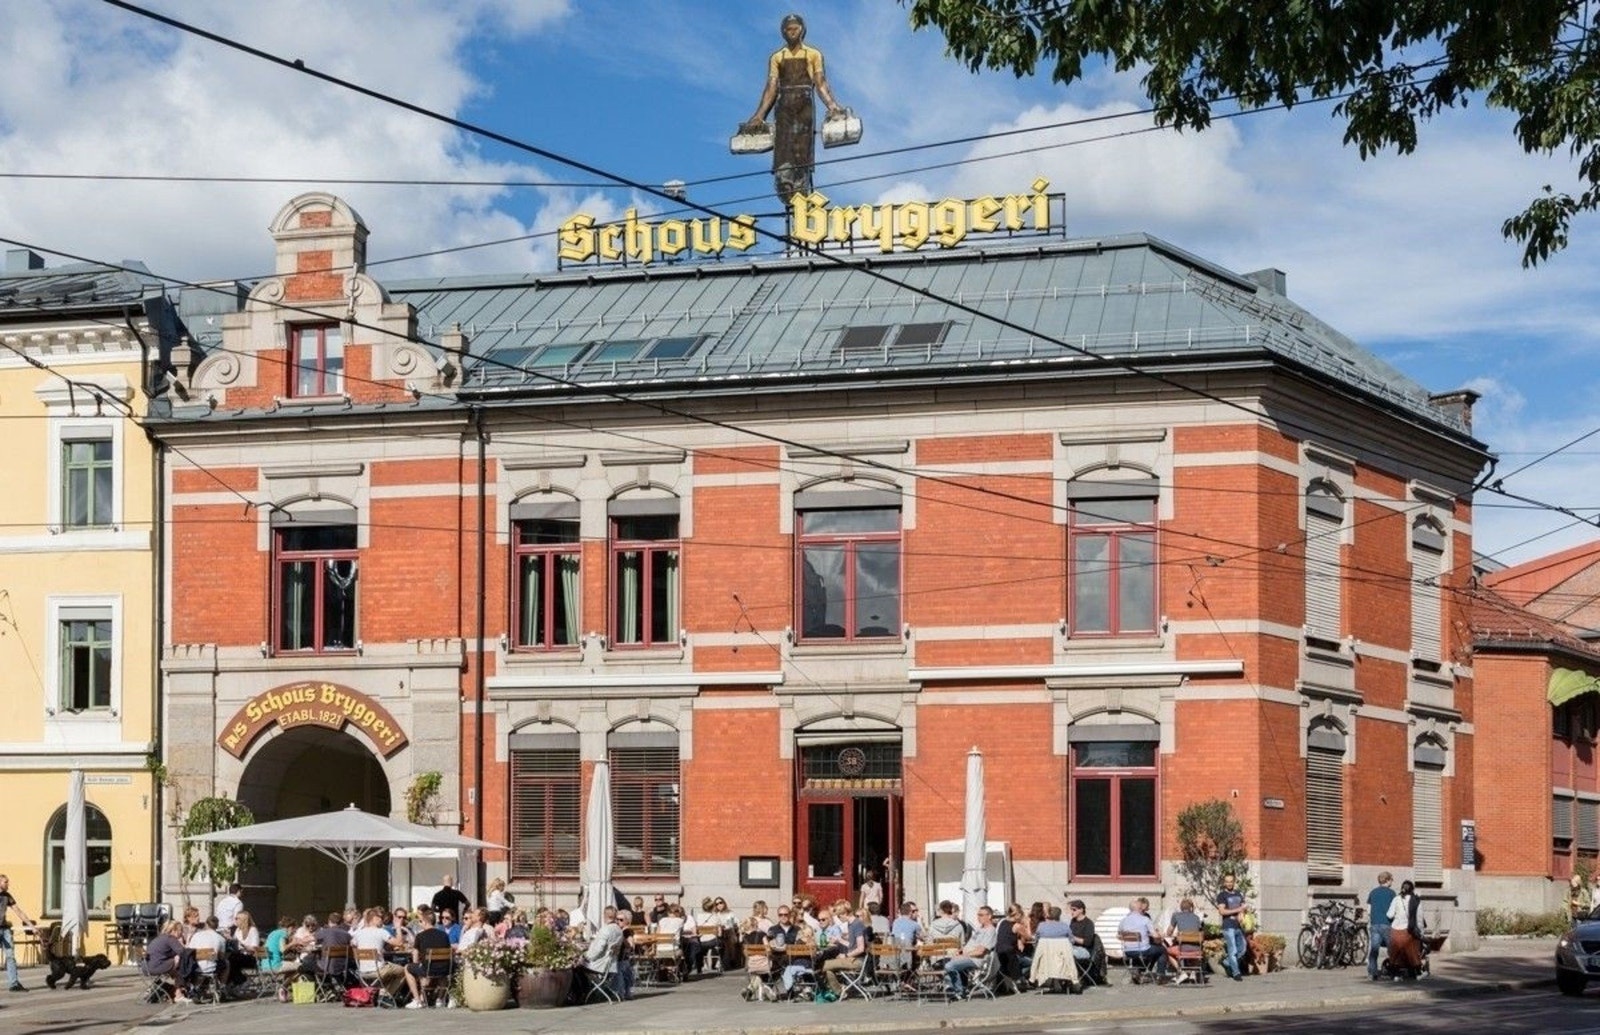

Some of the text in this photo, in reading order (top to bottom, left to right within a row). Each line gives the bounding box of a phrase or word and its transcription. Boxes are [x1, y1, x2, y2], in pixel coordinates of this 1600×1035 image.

[558, 176, 1050, 265] Schous Bryggeri
[246, 687, 316, 722] Schous
[320, 684, 400, 746] Bryggeri
[278, 710, 342, 726] ETABL. 1821
